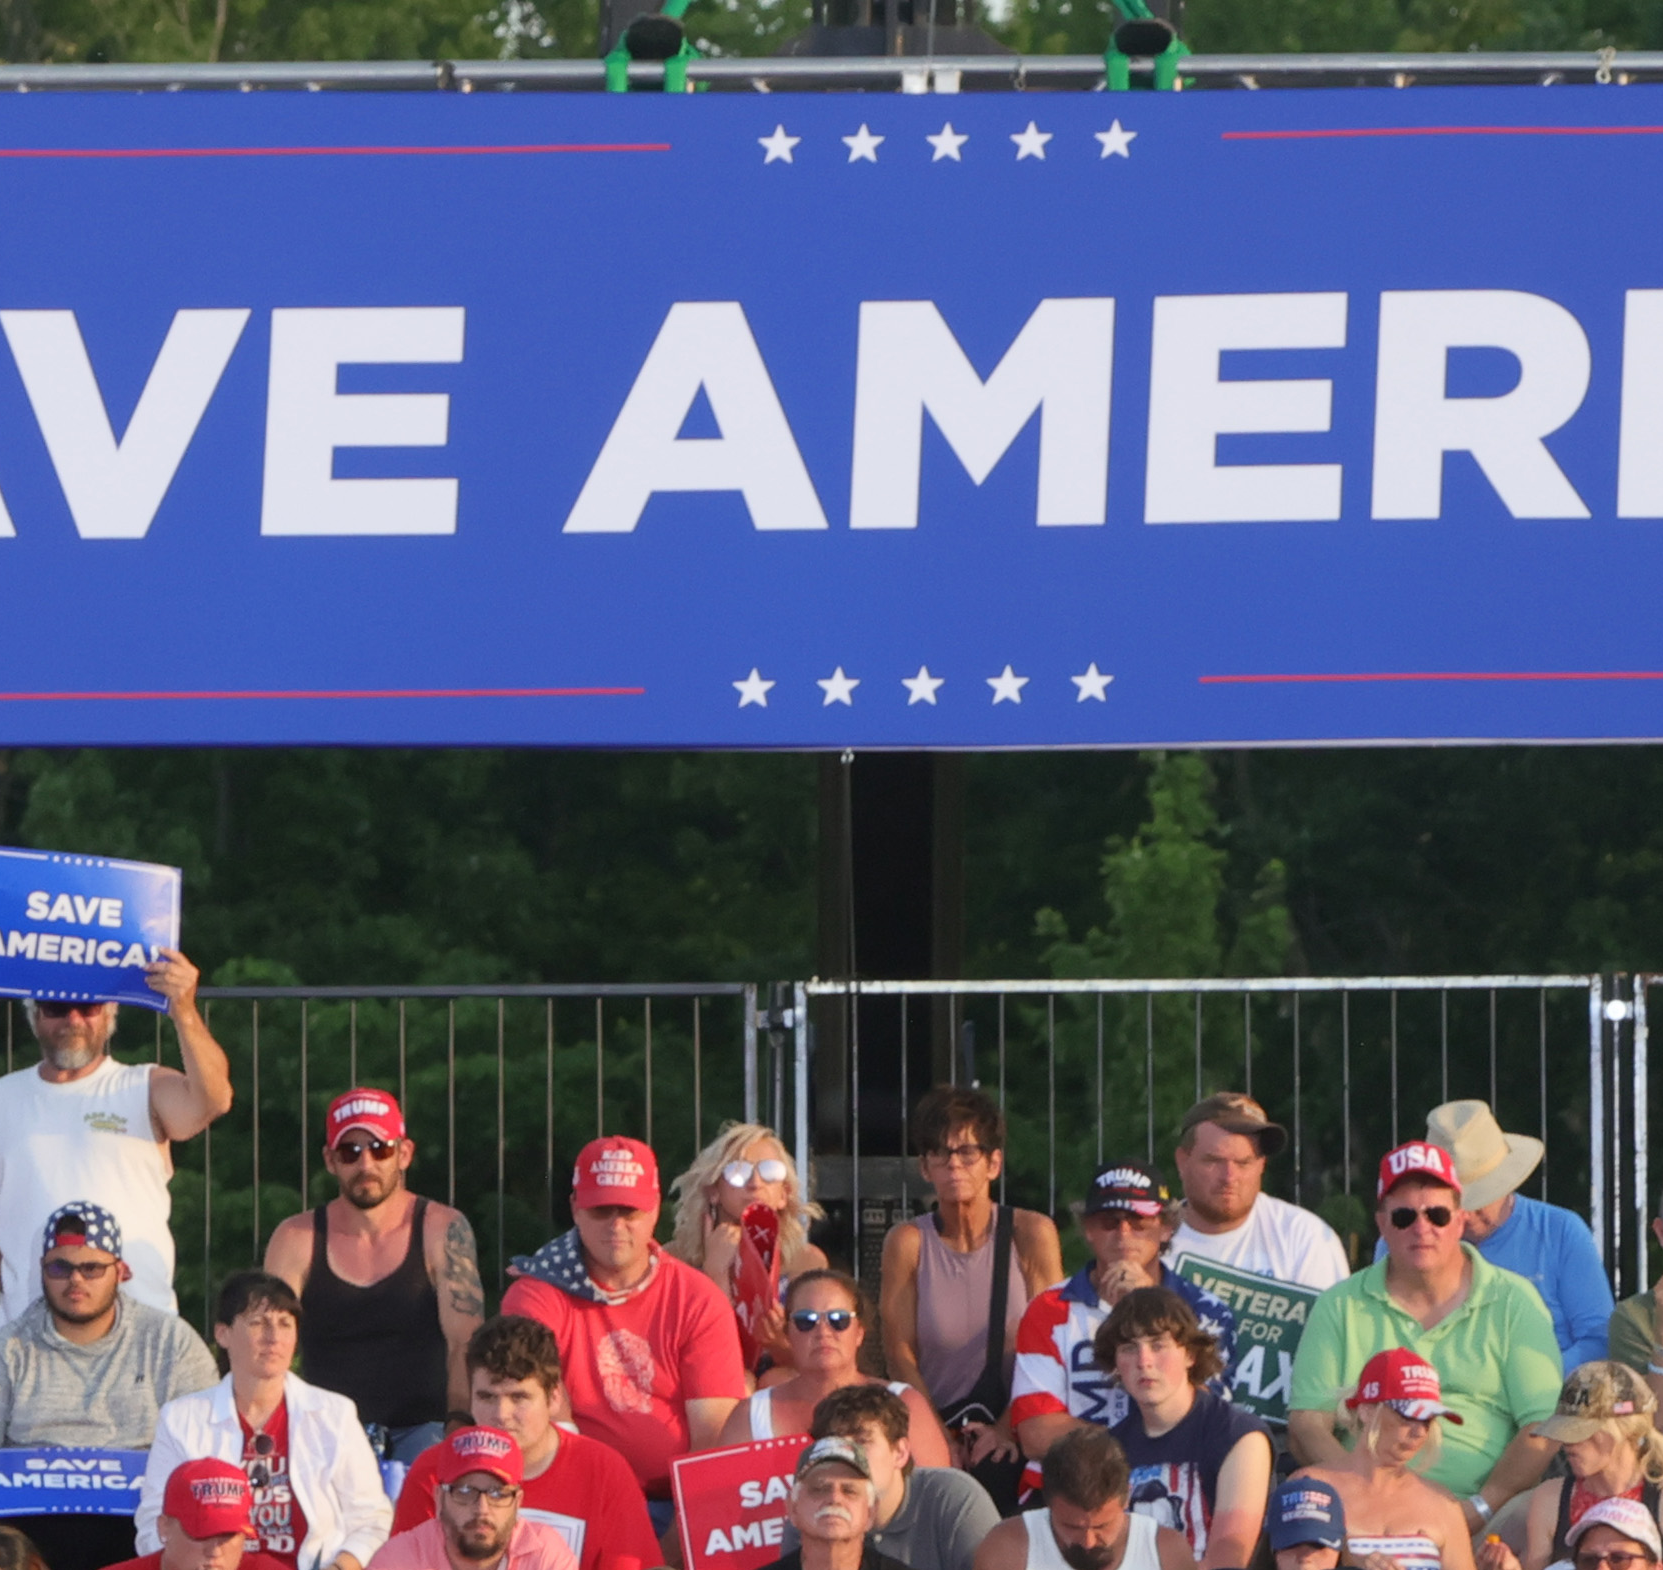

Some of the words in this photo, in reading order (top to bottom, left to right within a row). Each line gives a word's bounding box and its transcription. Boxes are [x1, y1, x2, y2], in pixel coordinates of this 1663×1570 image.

[26, 892, 123, 928] SAVE
[333, 1100, 390, 1122] TRUMP
[590, 1161, 645, 1176] AMERICA
[1389, 1145, 1444, 1174] USA
[596, 1174, 637, 1187] GREAT
[1097, 1168, 1151, 1188] TRUMP
[1237, 1319, 1283, 1344] FOR
[1362, 1383, 1380, 1399] 45
[24, 1458, 123, 1473] SAVE
[191, 1481, 244, 1497] TRUMP
